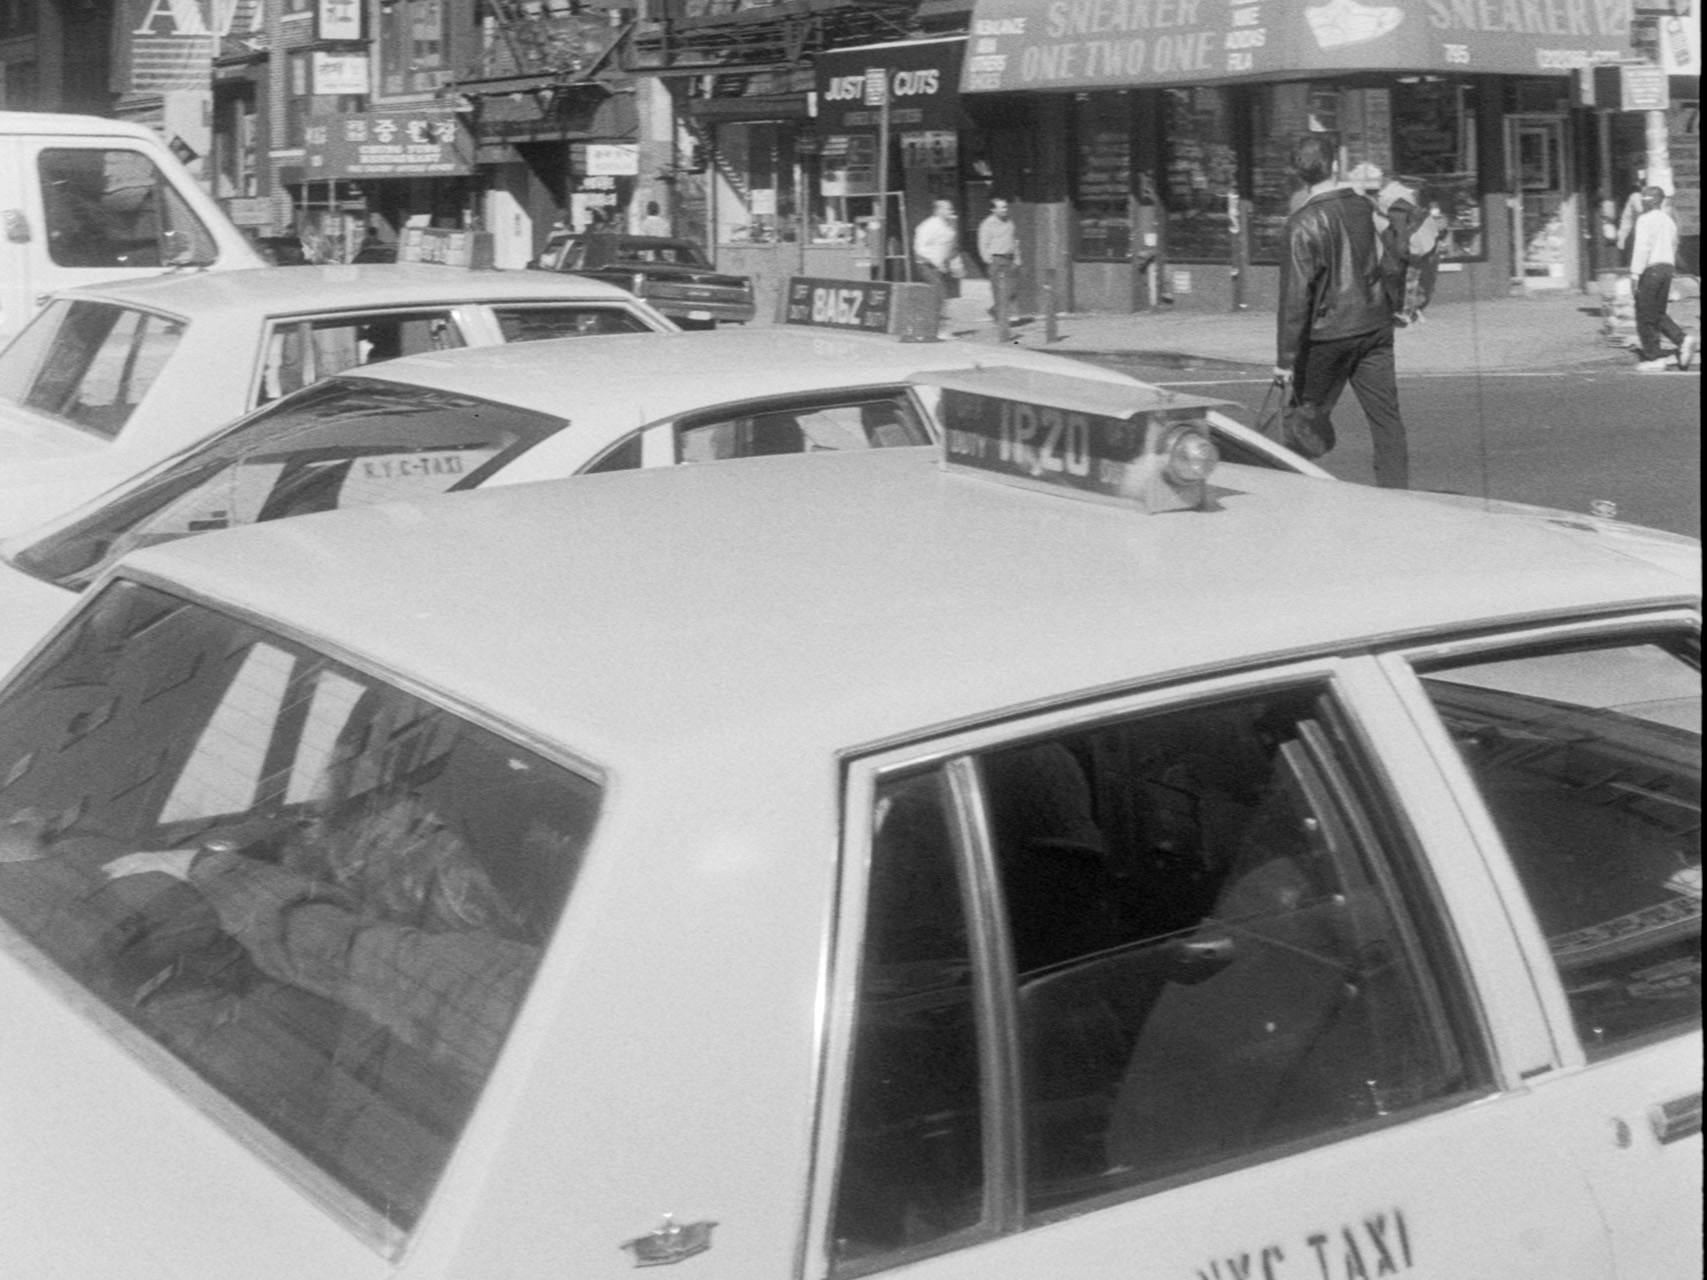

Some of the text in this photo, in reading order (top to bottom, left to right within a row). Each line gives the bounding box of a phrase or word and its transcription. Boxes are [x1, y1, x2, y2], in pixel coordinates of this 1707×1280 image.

[1021, 42, 1079, 82] ONE
[1085, 38, 1148, 78] TWO
[1154, 31, 1217, 77] ONE
[824, 75, 866, 101] JUST
[893, 68, 940, 96] CUTS
[1305, 1203, 1412, 1280] TAXI
